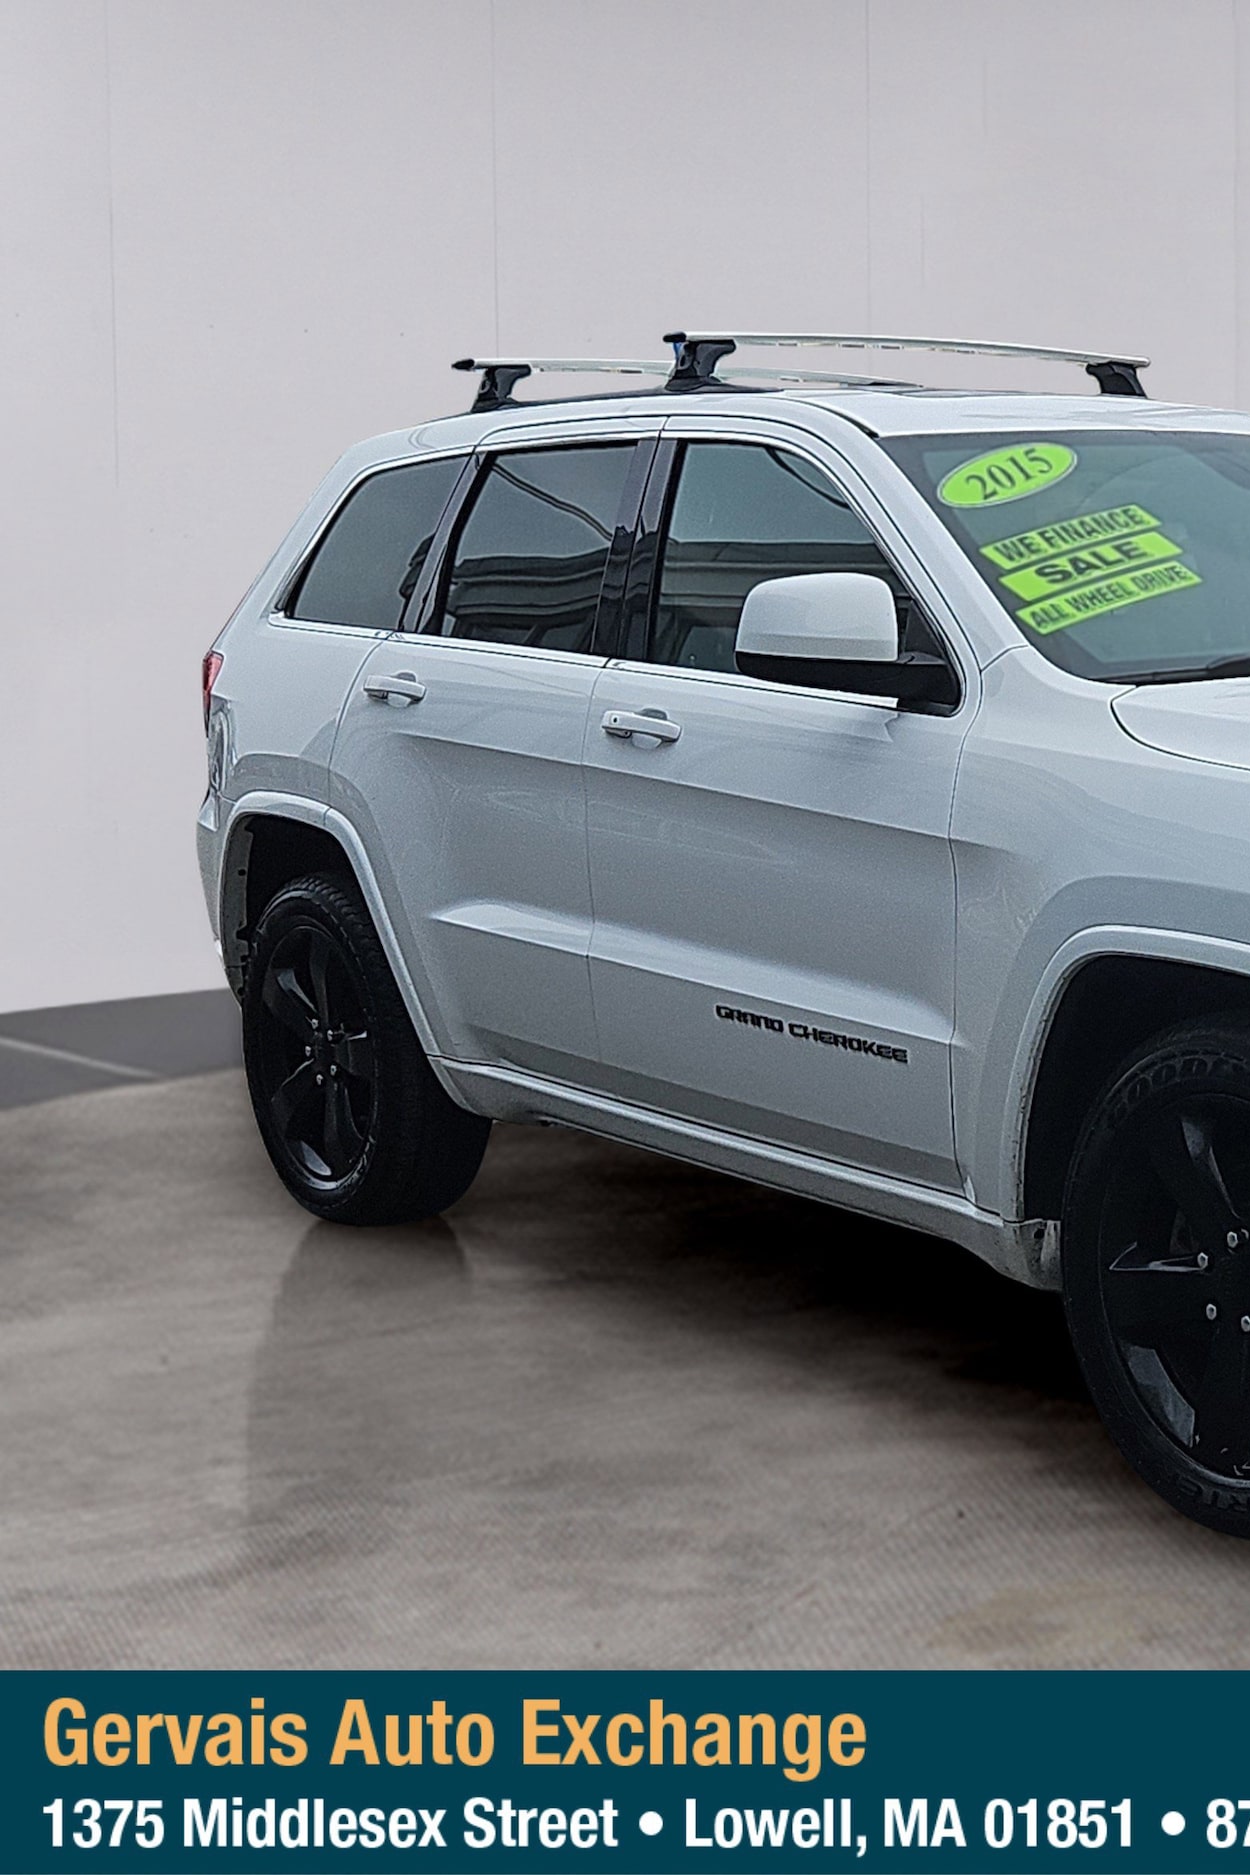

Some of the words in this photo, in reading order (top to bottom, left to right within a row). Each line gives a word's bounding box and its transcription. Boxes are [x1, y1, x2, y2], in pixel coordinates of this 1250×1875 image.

[965, 448, 1054, 501] 2015
[993, 535, 1042, 564] WE
[1039, 507, 1147, 551] FINANCE
[1034, 541, 1150, 585] SALE
[1030, 603, 1069, 630] ALL
[1067, 582, 1131, 615] WHEEL
[1136, 562, 1191, 594] DRIVE
[716, 1004, 784, 1033] GRAND
[788, 1022, 909, 1064] CHEROKEE
